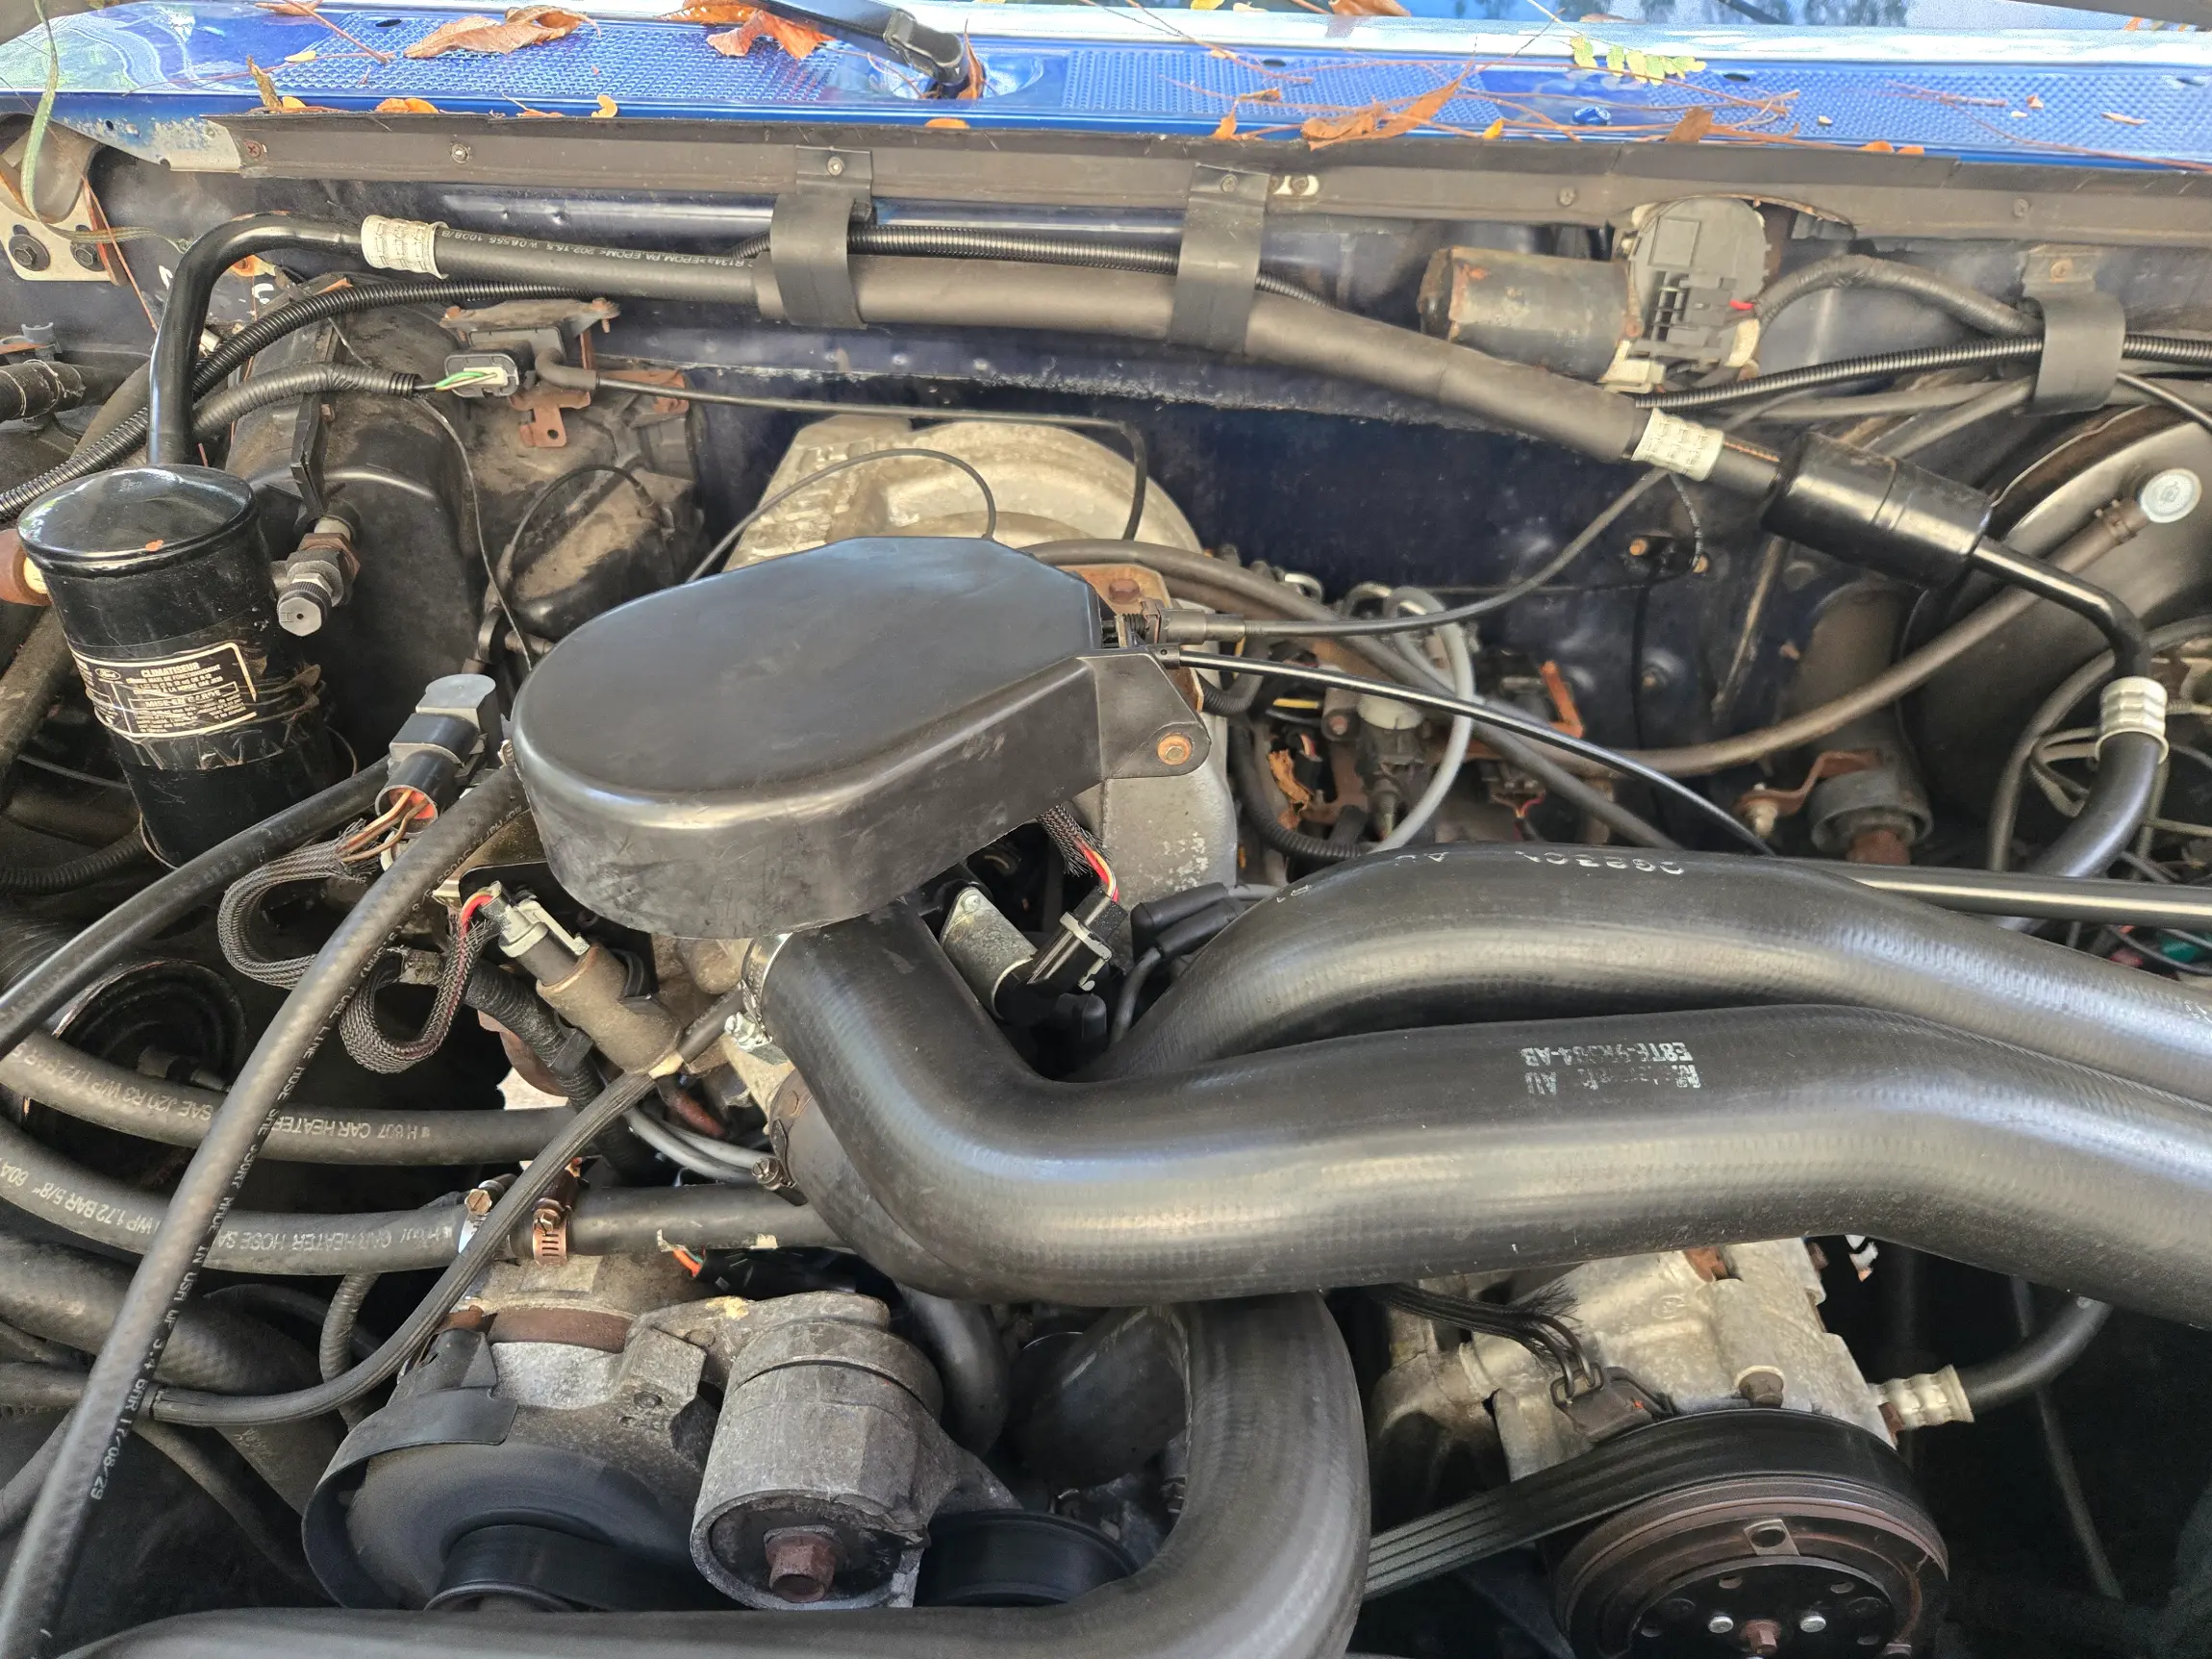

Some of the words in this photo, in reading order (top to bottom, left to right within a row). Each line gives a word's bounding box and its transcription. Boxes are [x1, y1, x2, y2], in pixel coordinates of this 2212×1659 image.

[140, 662, 200, 678] CLIMATISEUR
[303, 1026, 331, 1059] LINE
[90, 1079, 122, 1099] WP
[277, 1067, 307, 1101] HOSE
[123, 1086, 145, 1106] R3
[176, 1099, 214, 1121] SAE
[258, 1108, 281, 1136] SAE
[338, 1121, 371, 1139] CAR
[64, 1193, 98, 1219] BAR
[96, 1203, 127, 1224] 1.72
[208, 1196, 236, 1234] MADE
[217, 1230, 238, 1249] SA
[239, 1232, 287, 1251] HOSE
[291, 1232, 353, 1251] HEATER
[192, 1244, 211, 1264] IN
[173, 1272, 197, 1301] USA
[125, 1379, 148, 1412] BAR
